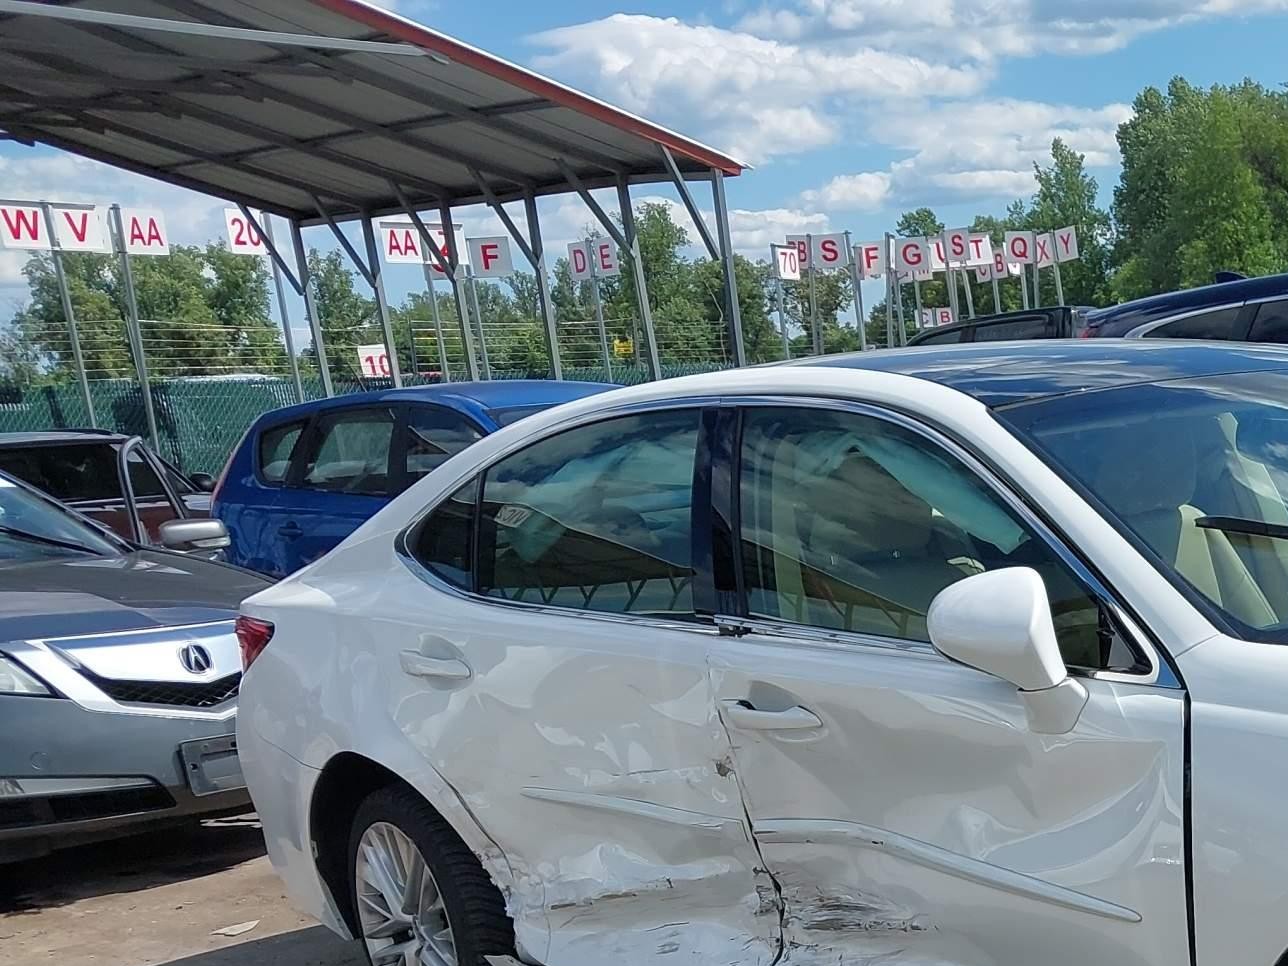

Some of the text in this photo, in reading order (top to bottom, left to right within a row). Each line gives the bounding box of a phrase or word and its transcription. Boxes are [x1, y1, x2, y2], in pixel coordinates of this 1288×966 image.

[1, 208, 39, 241] W
[63, 211, 88, 242] V
[130, 216, 164, 247] AA
[231, 218, 261, 246] 20
[388, 229, 419, 256] AA
[821, 239, 838, 262] S
[951, 234, 964, 256] S
[970, 239, 983, 259] T
[1010, 237, 1028, 259] Q
[1037, 240, 1050, 263] X
[1060, 232, 1071, 254] Y
[480, 244, 499, 270] F
[573, 249, 586, 274] D
[599, 244, 613, 270] E
[780, 251, 797, 274] 70
[864, 247, 878, 269] F
[902, 243, 922, 266] G
[940, 311, 951, 323] B
[365, 354, 391, 376] 10
